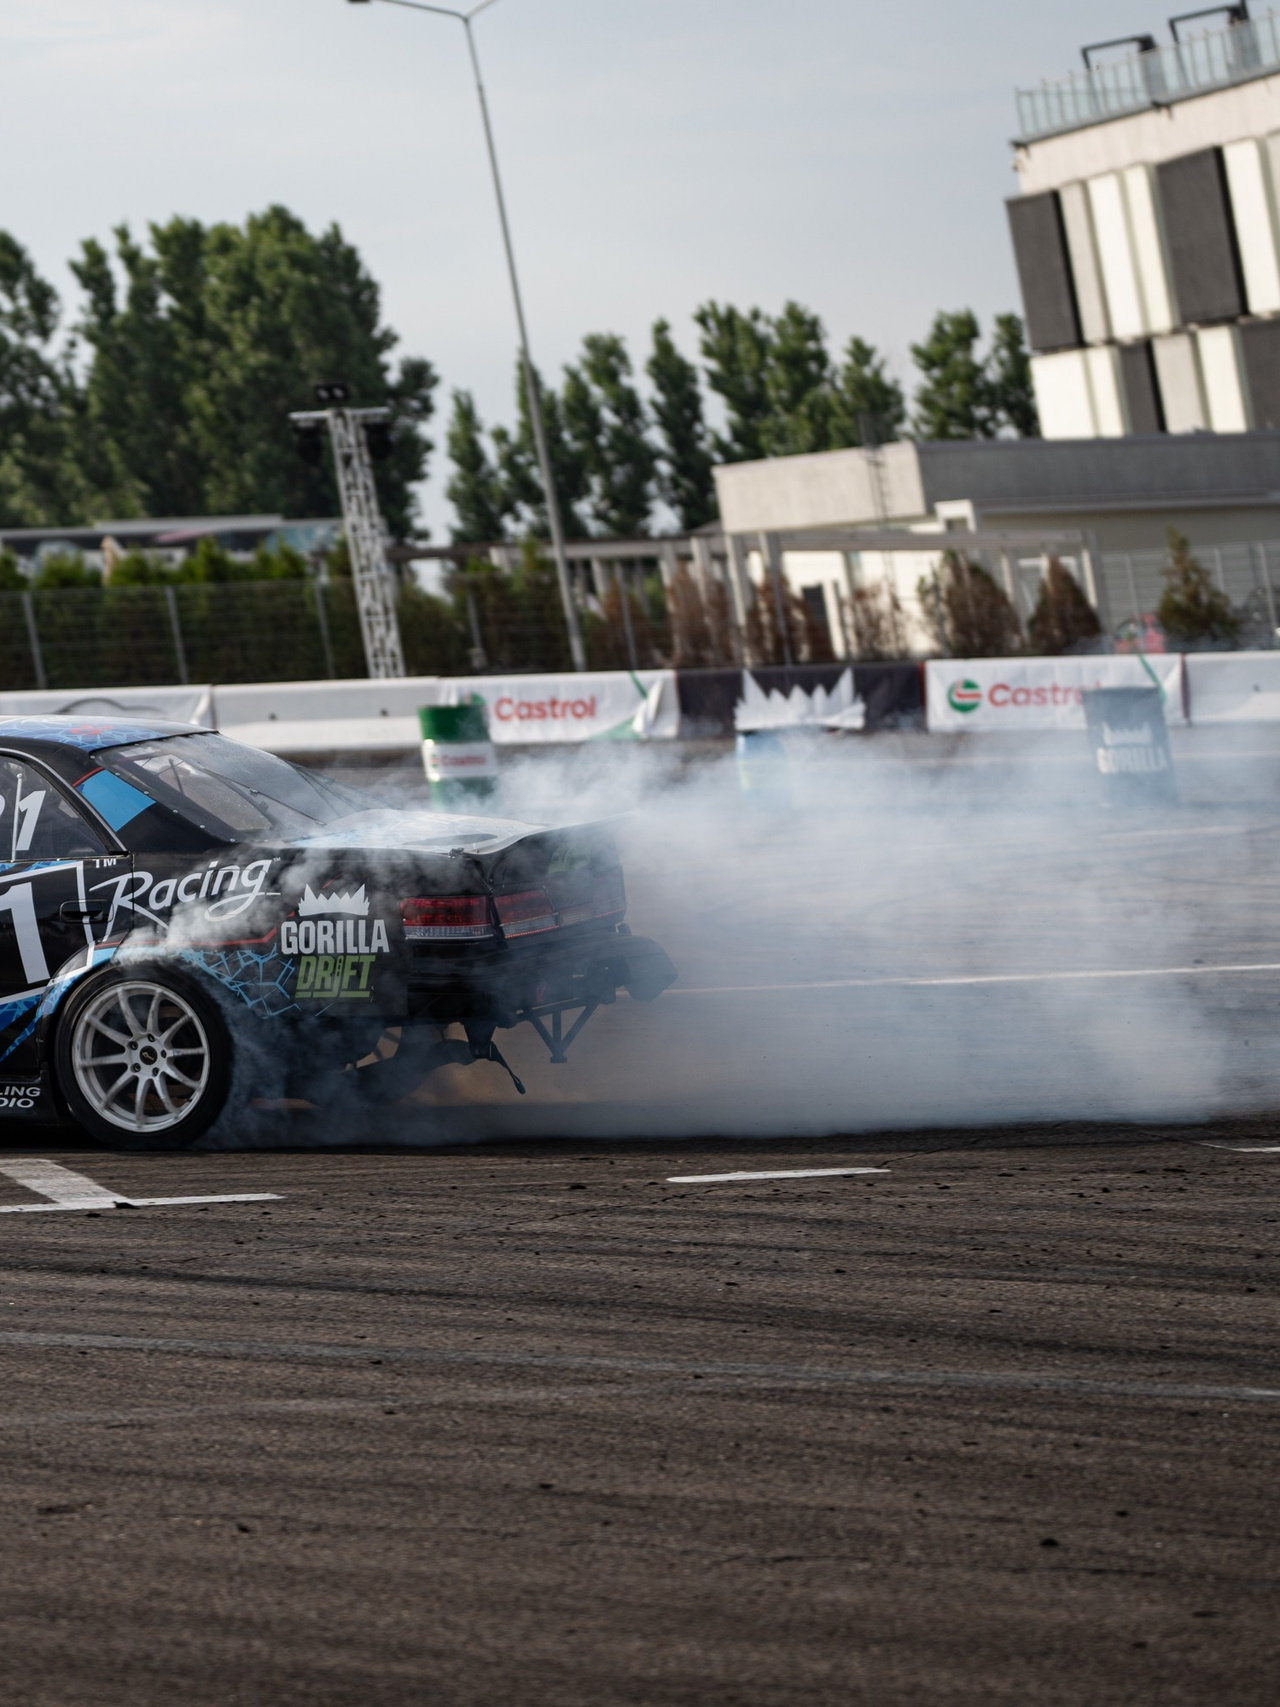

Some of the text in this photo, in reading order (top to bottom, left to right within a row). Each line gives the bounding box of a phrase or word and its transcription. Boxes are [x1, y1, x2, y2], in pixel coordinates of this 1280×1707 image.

[494, 695, 597, 722] Castrol
[987, 680, 1103, 708] Castr
[89, 859, 281, 942] Racing
[280, 919, 390, 955] GORILLA
[295, 954, 376, 998] DRIFT
